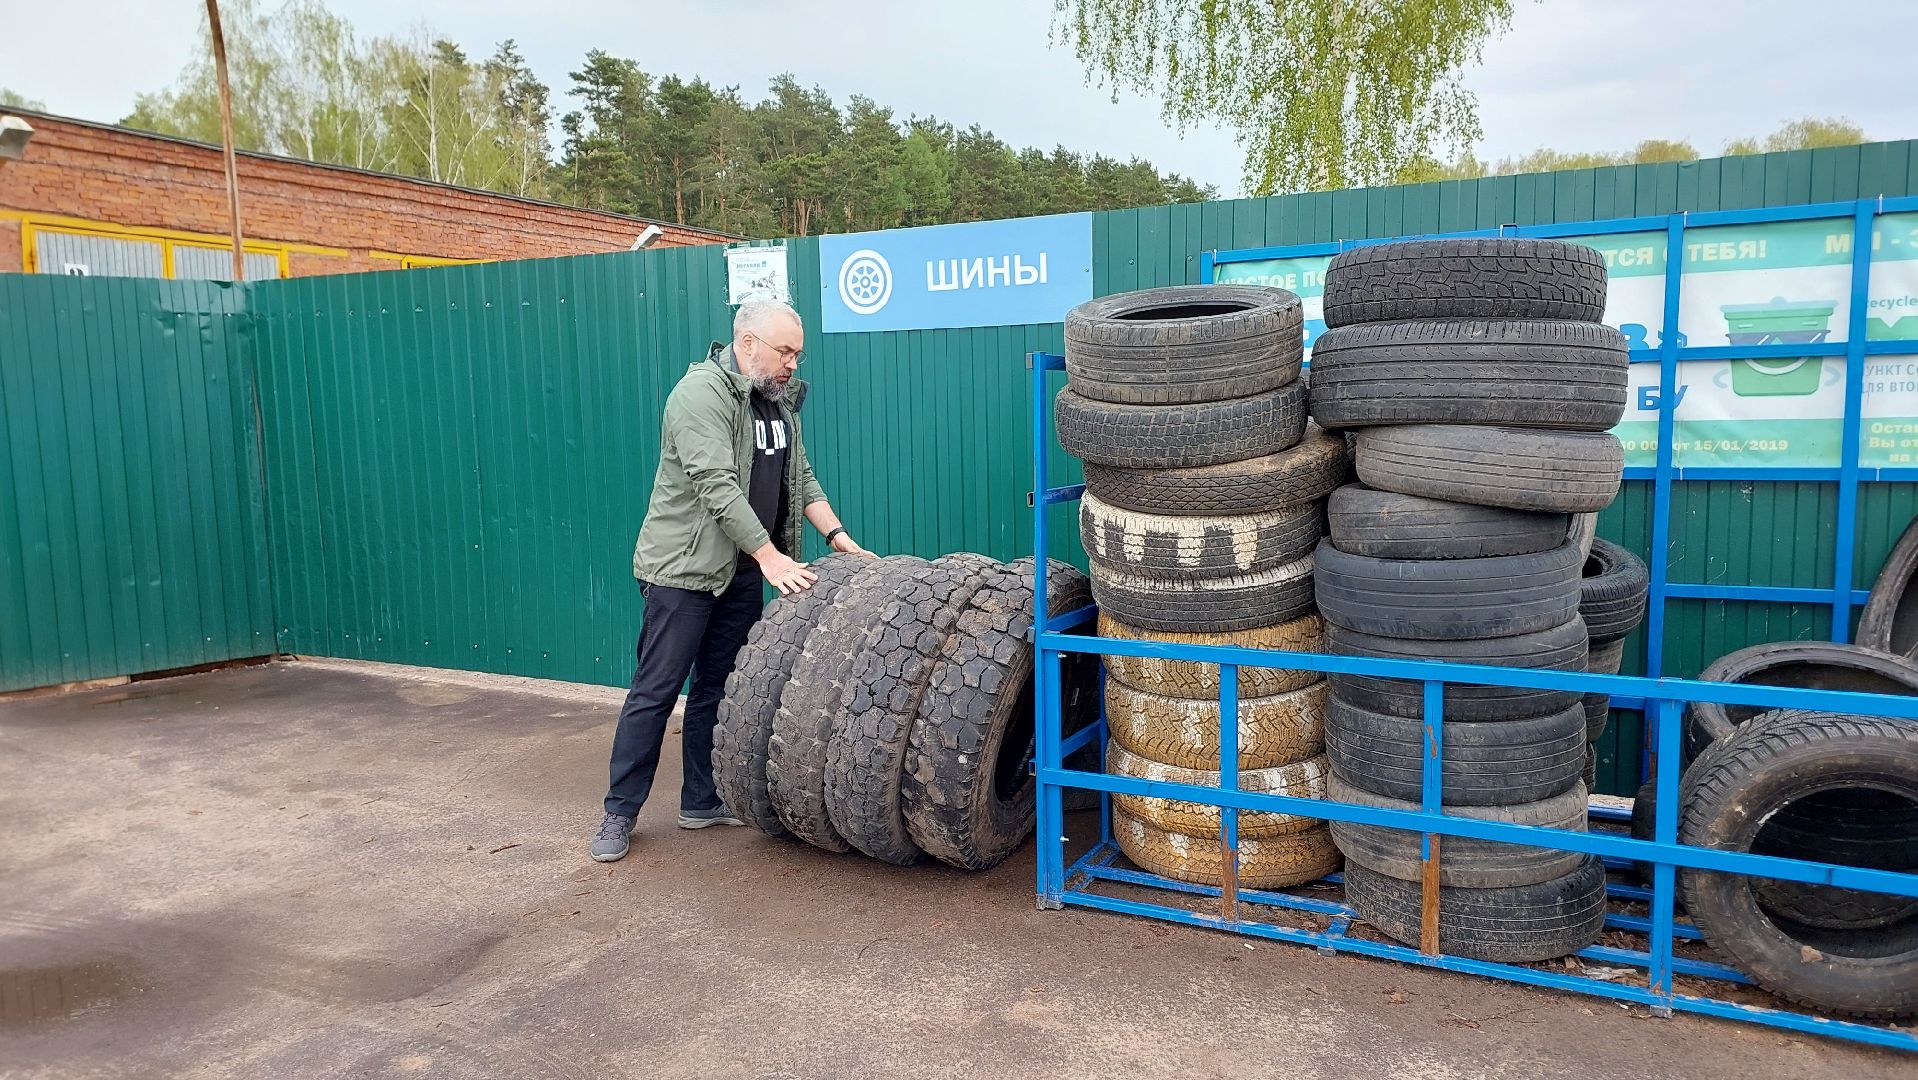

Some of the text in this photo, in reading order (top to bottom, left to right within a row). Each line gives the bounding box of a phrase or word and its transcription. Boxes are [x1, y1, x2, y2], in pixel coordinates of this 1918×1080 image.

[1601, 247, 1654, 267] ТСЯ
[1688, 240, 1767, 262] ТЕБЯ!
[926, 252, 1048, 292] ШИНЫ
[1870, 296, 1918, 310] ecycle
[1866, 364, 1902, 376] УНКТ
[1864, 382, 1884, 393] ЛЯ
[1693, 439, 1788, 453] 15/01/2019
[1869, 437, 1895, 448] Вы
